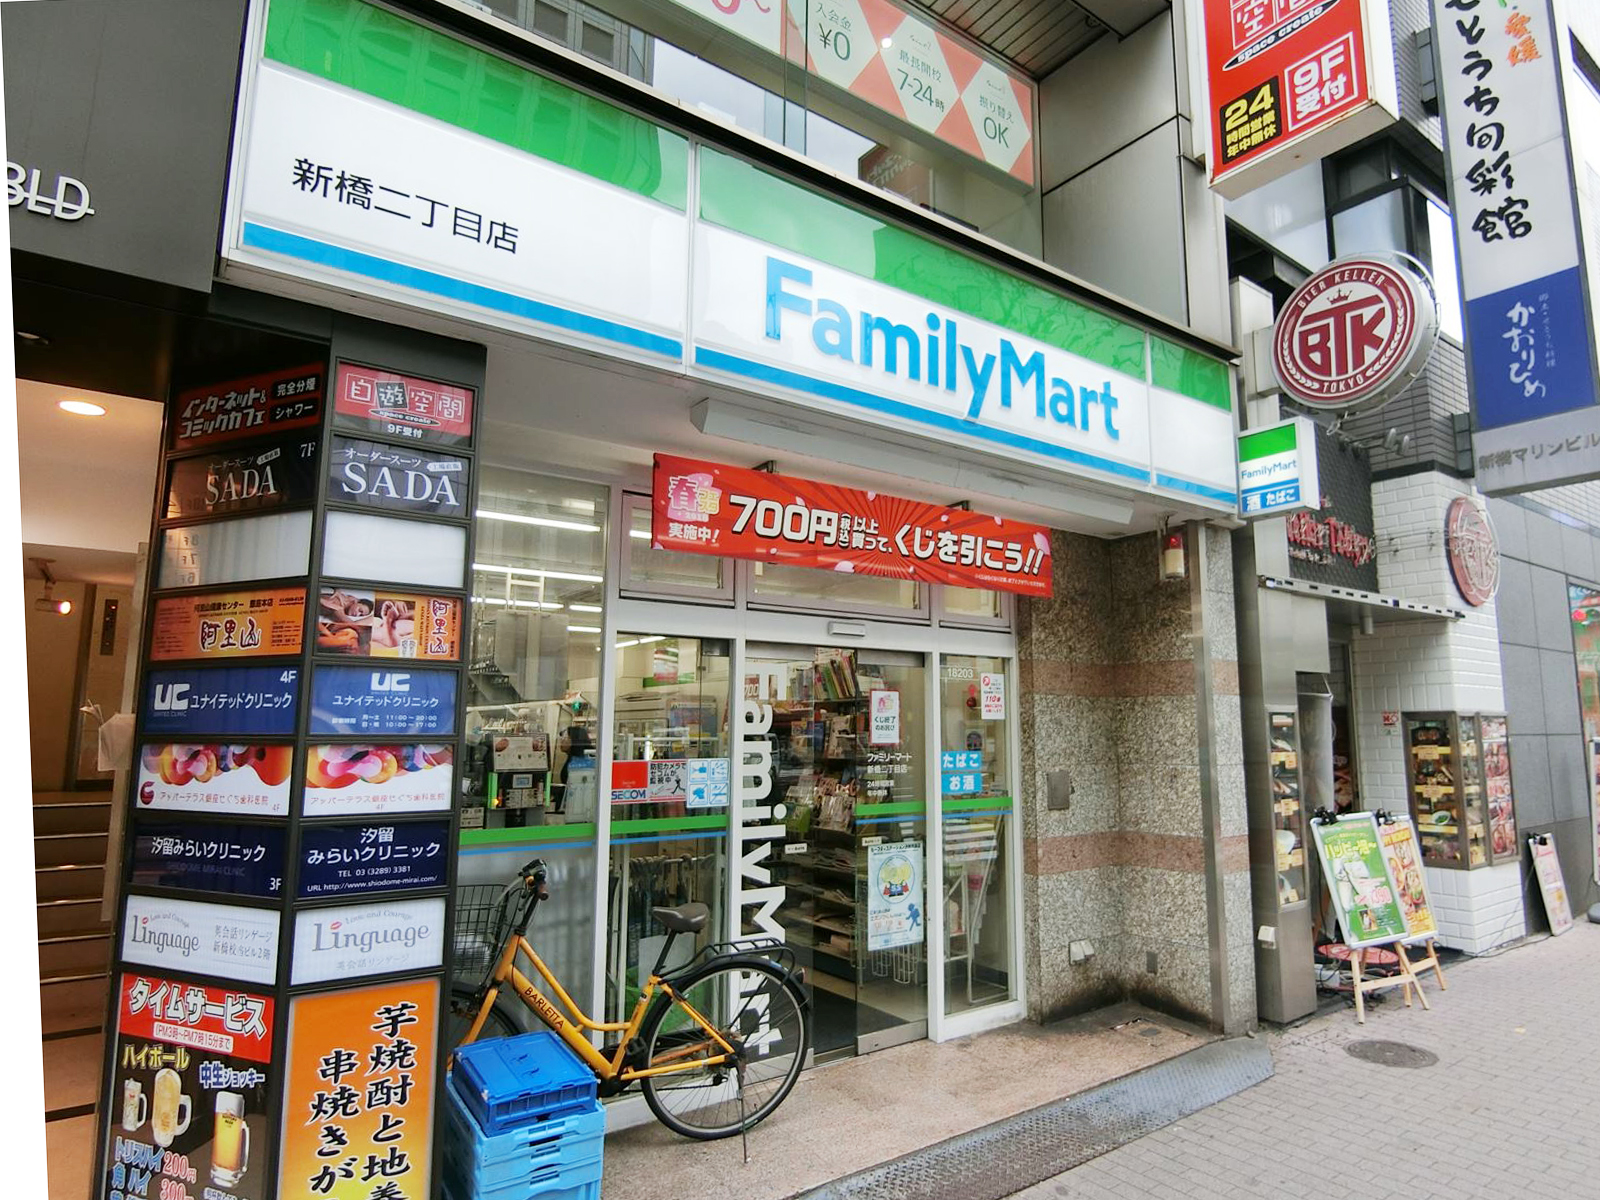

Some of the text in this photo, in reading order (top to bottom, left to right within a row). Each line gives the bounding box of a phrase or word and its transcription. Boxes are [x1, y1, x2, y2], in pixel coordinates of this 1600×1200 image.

[819, 23, 850, 61] ¥0
[1293, 44, 1345, 94] 9F
[897, 68, 945, 112] 7-24時
[1296, 73, 1347, 119] 受付
[1225, 84, 1274, 131] 24
[983, 117, 1009, 148] OK
[1226, 110, 1276, 145] 時間営業
[291, 157, 520, 256] 新橋二丁目店
[1298, 270, 1386, 308] BIER KELLER
[765, 255, 1120, 441] FamilyMart
[1298, 294, 1386, 378] BTK
[1502, 301, 1546, 397] かおりひめ
[1323, 374, 1363, 393] TOKYO
[275, 403, 313, 419] シャワー
[351, 379, 462, 418] 自遊空間
[179, 407, 265, 438] コミックカフェ
[387, 424, 423, 438] 9F受付
[300, 442, 316, 458] 7F
[345, 448, 421, 467] オーダースーツ
[1241, 459, 1297, 480] FamilyMart
[205, 465, 277, 505] SADA
[342, 461, 460, 506] SADA
[1246, 489, 1296, 511] 酒 たばこ
[669, 522, 719, 543] 実施中!
[729, 494, 839, 546] 700円
[200, 617, 262, 652] 阿里山
[429, 599, 452, 655] 阿里山
[280, 670, 297, 683] 4F
[371, 672, 410, 691] UC
[948, 668, 973, 678] 18203
[154, 683, 190, 710] UC
[190, 692, 292, 709] ユナイテッドクリニック
[332, 695, 439, 708] ユナイテッドクリニック
[867, 753, 912, 762] ファミリーマート
[942, 753, 979, 769] たばこ
[611, 789, 646, 800] SECOM
[949, 774, 975, 791] お酒
[360, 826, 394, 844] 汐留
[151, 837, 266, 862] 汐留みらいクリニック
[307, 842, 441, 865] みらいクリニック
[269, 877, 282, 890] 3F
[323, 875, 438, 891] http://www.shiodome-mirai.com/
[367, 867, 392, 876] (3289)
[393, 865, 411, 874] 3381
[131, 915, 200, 957] Linguage
[312, 923, 432, 953] Linguage
[129, 977, 267, 1040] タイムサービス
[524, 986, 565, 1030] BARLETTA
[122, 1043, 190, 1070] ハイボール
[199, 1061, 266, 1089] 中生ジョッキー
[163, 1151, 197, 1184] 200円
